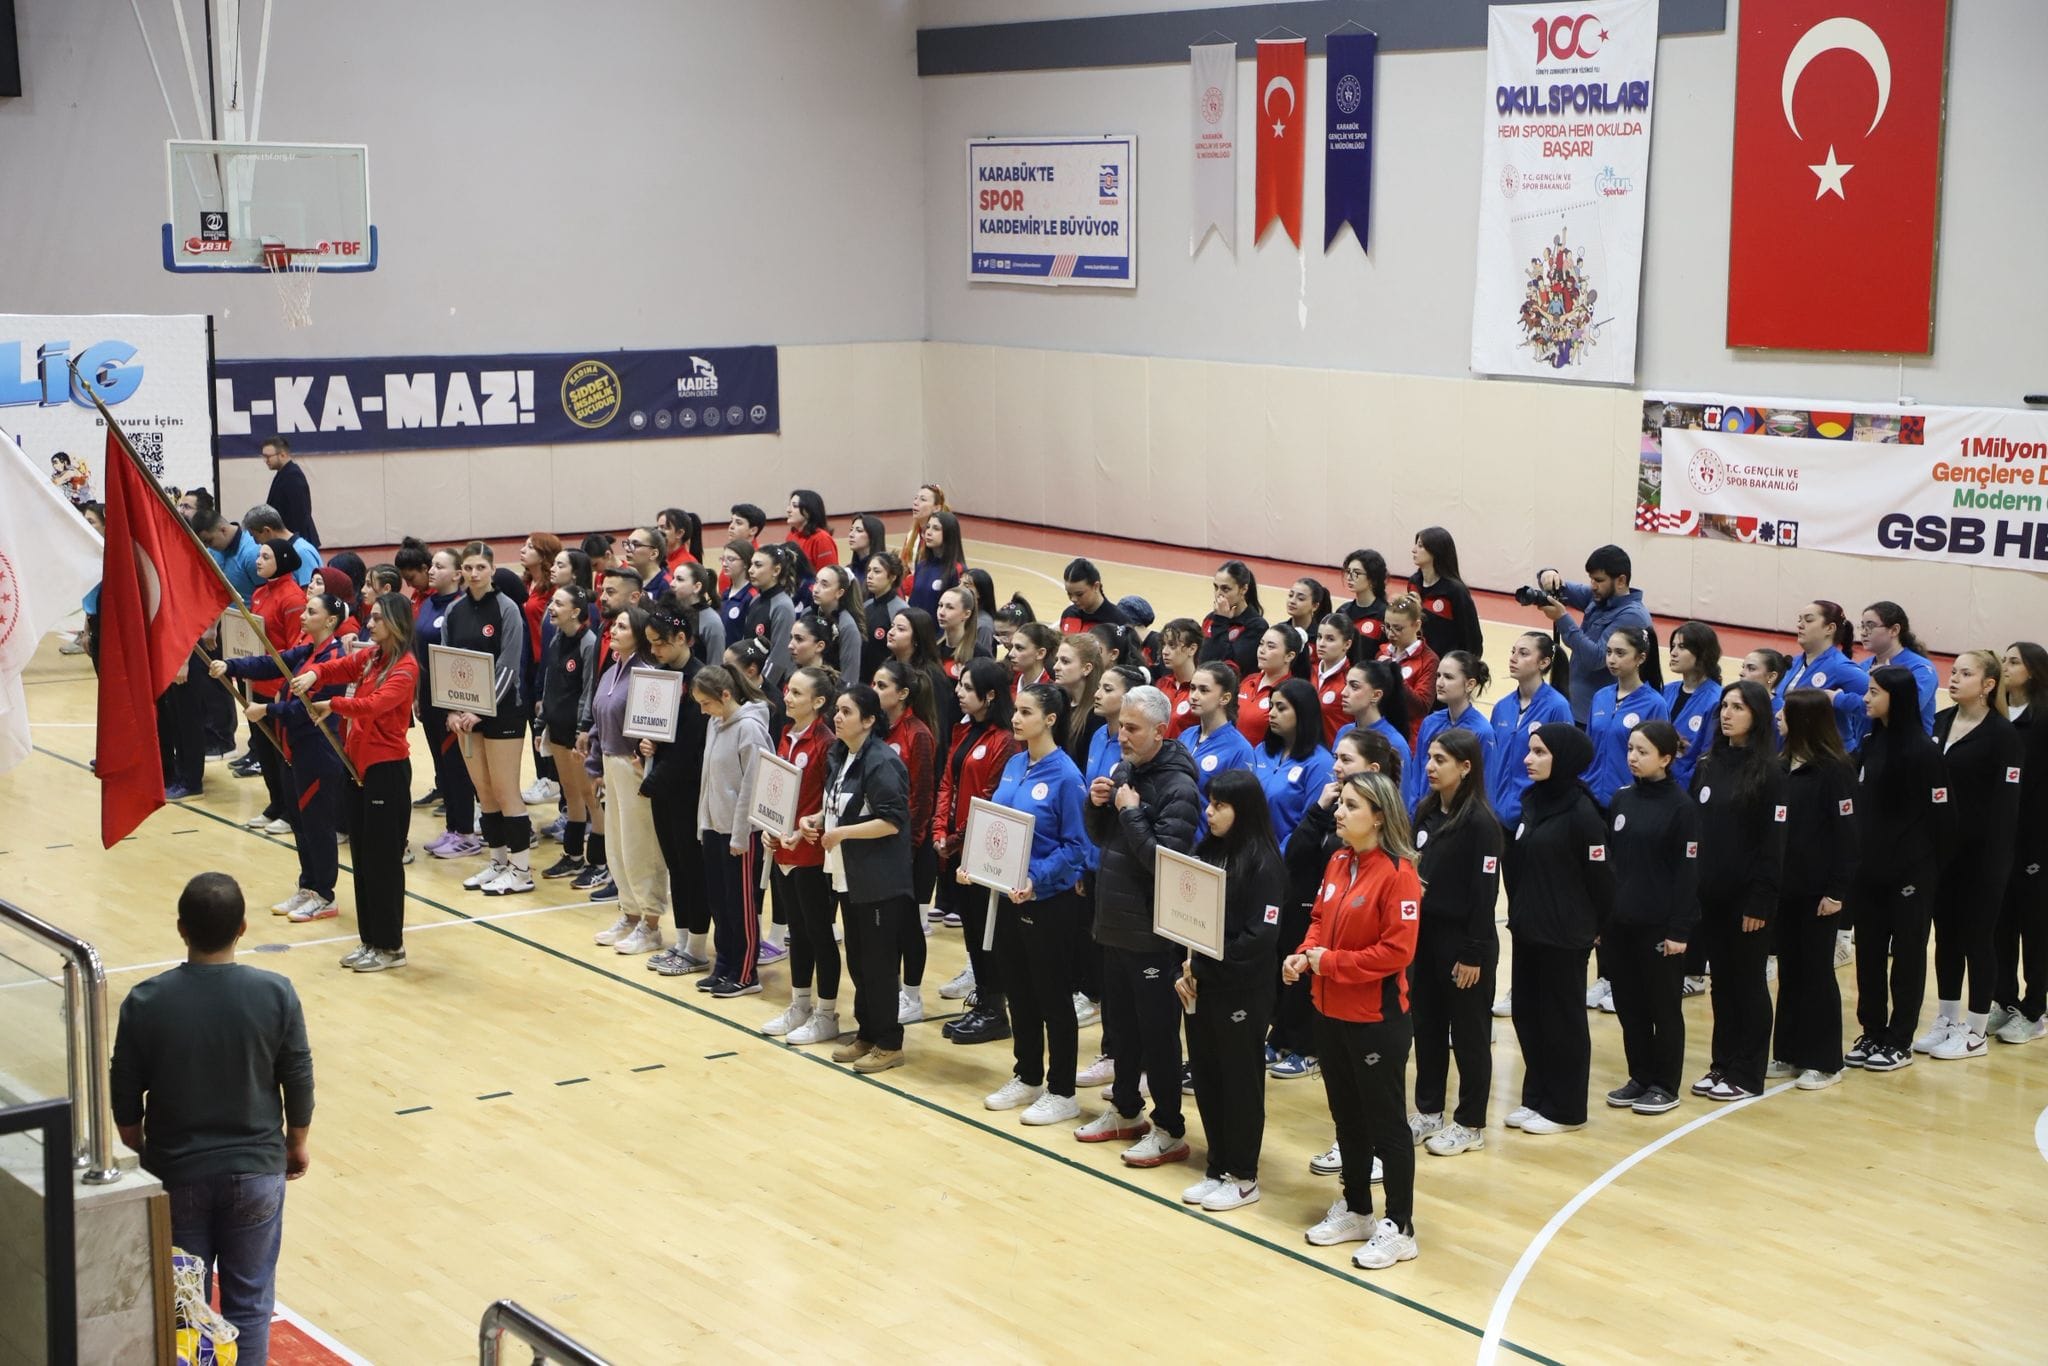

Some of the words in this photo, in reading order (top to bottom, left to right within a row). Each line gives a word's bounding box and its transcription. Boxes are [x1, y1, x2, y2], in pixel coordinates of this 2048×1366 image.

[1496, 85, 1547, 115] OKUL
[1548, 80, 1650, 115] SPORLARI
[1498, 125, 1520, 138] HEM
[1522, 124, 1567, 138] SPORDA
[1568, 123, 1593, 137] HEM
[1595, 122, 1642, 137] OKULDA
[1542, 141, 1594, 160] BAŞARI
[979, 162, 1054, 182] KARABÜK'TE
[979, 189, 1024, 212] SPOR
[980, 215, 1058, 235] KARDEMİR'LE
[1060, 215, 1119, 236] BÜYÜYOR
[331, 241, 361, 256] TBF
[568, 365, 599, 385] KADINA
[677, 376, 719, 391] KADES
[95, 418, 150, 427] Bvuru
[154, 415, 184, 428] İçin:
[1960, 437, 1970, 457] 1
[1972, 437, 2047, 463] Milyon
[1726, 464, 1741, 474] T.C.
[1744, 465, 1784, 478] GENÇLİK
[1787, 468, 1799, 479] VE
[1932, 462, 2035, 490] Gençlere
[1726, 476, 1748, 487] SPOR
[1749, 479, 1799, 491] BAKANLIĞI
[1952, 488, 2042, 512] Modern
[1877, 513, 1986, 555] GSB
[447, 689, 481, 703] ÇORUM
[631, 714, 668, 728] KASTAMONU
[757, 802, 785, 825] SAMSUN
